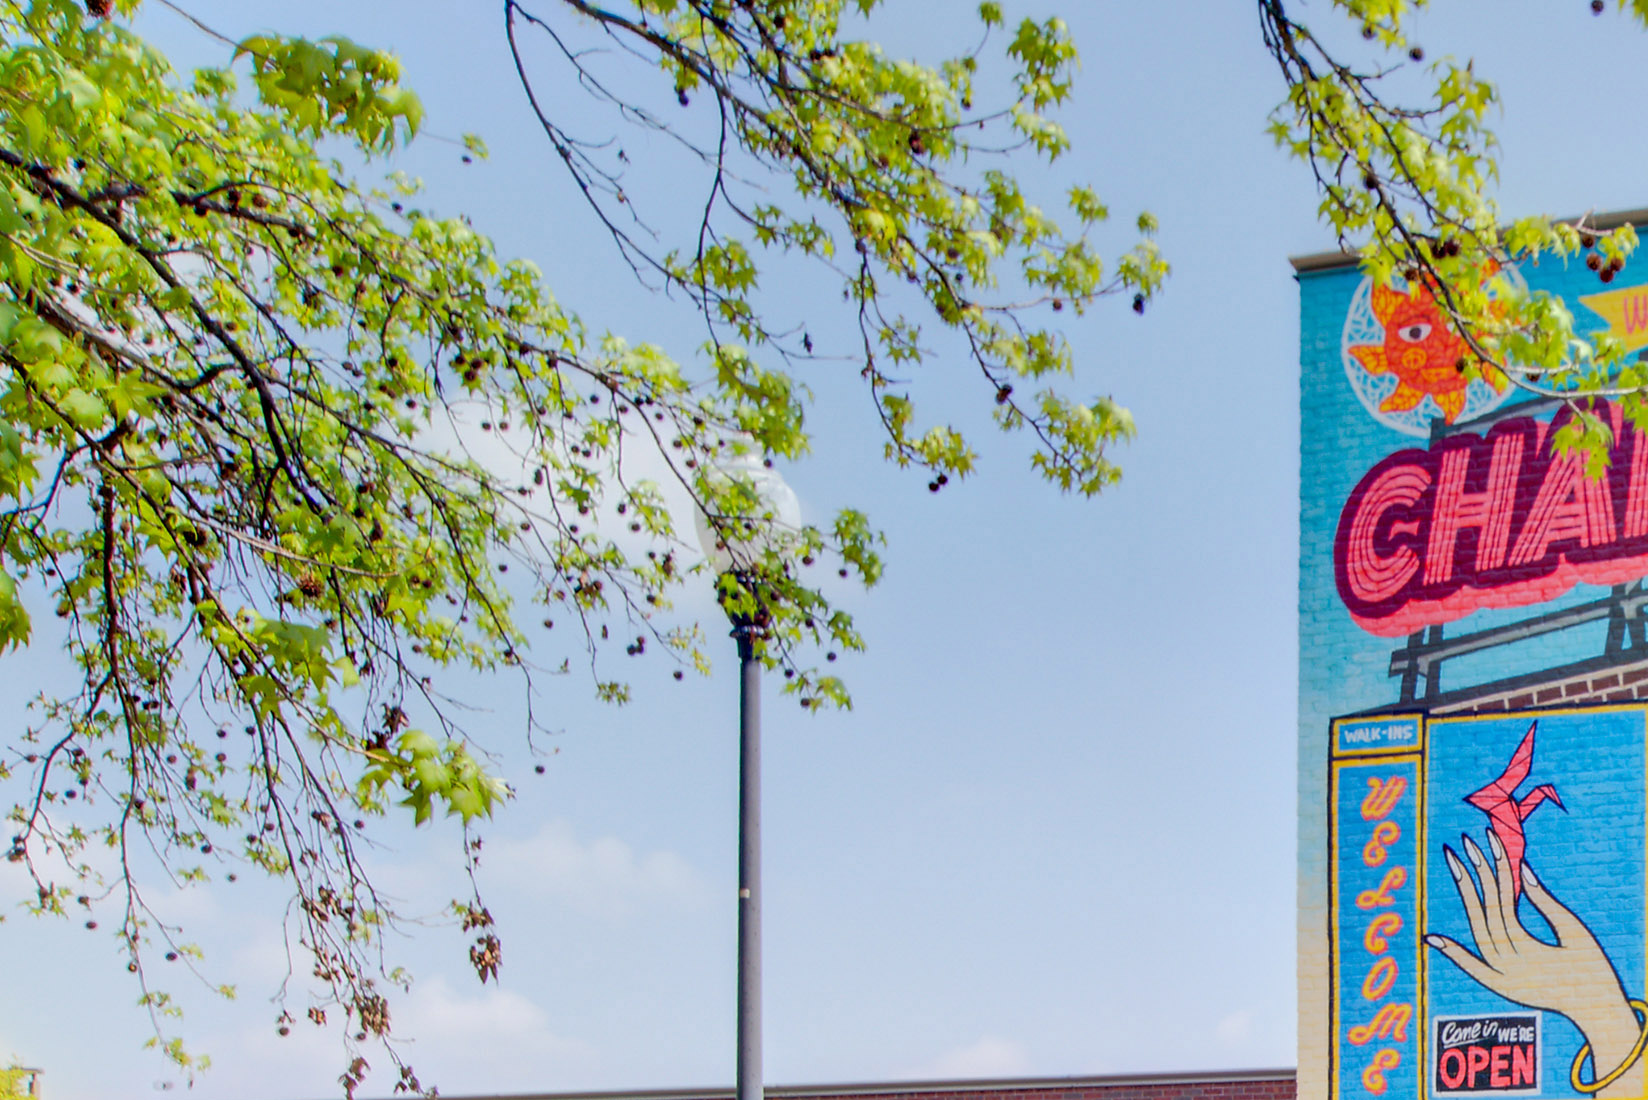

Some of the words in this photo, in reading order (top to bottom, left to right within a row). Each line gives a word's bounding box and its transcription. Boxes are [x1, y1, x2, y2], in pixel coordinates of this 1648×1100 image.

[1344, 725, 1414, 743] WALK-INS
[1348, 775, 1412, 1096] WELCOME
[1442, 1021, 1482, 1045] Come
[1482, 1019, 1498, 1037] in
[1498, 1025, 1535, 1042] WE'RE
[1440, 1044, 1534, 1089] OPEN
